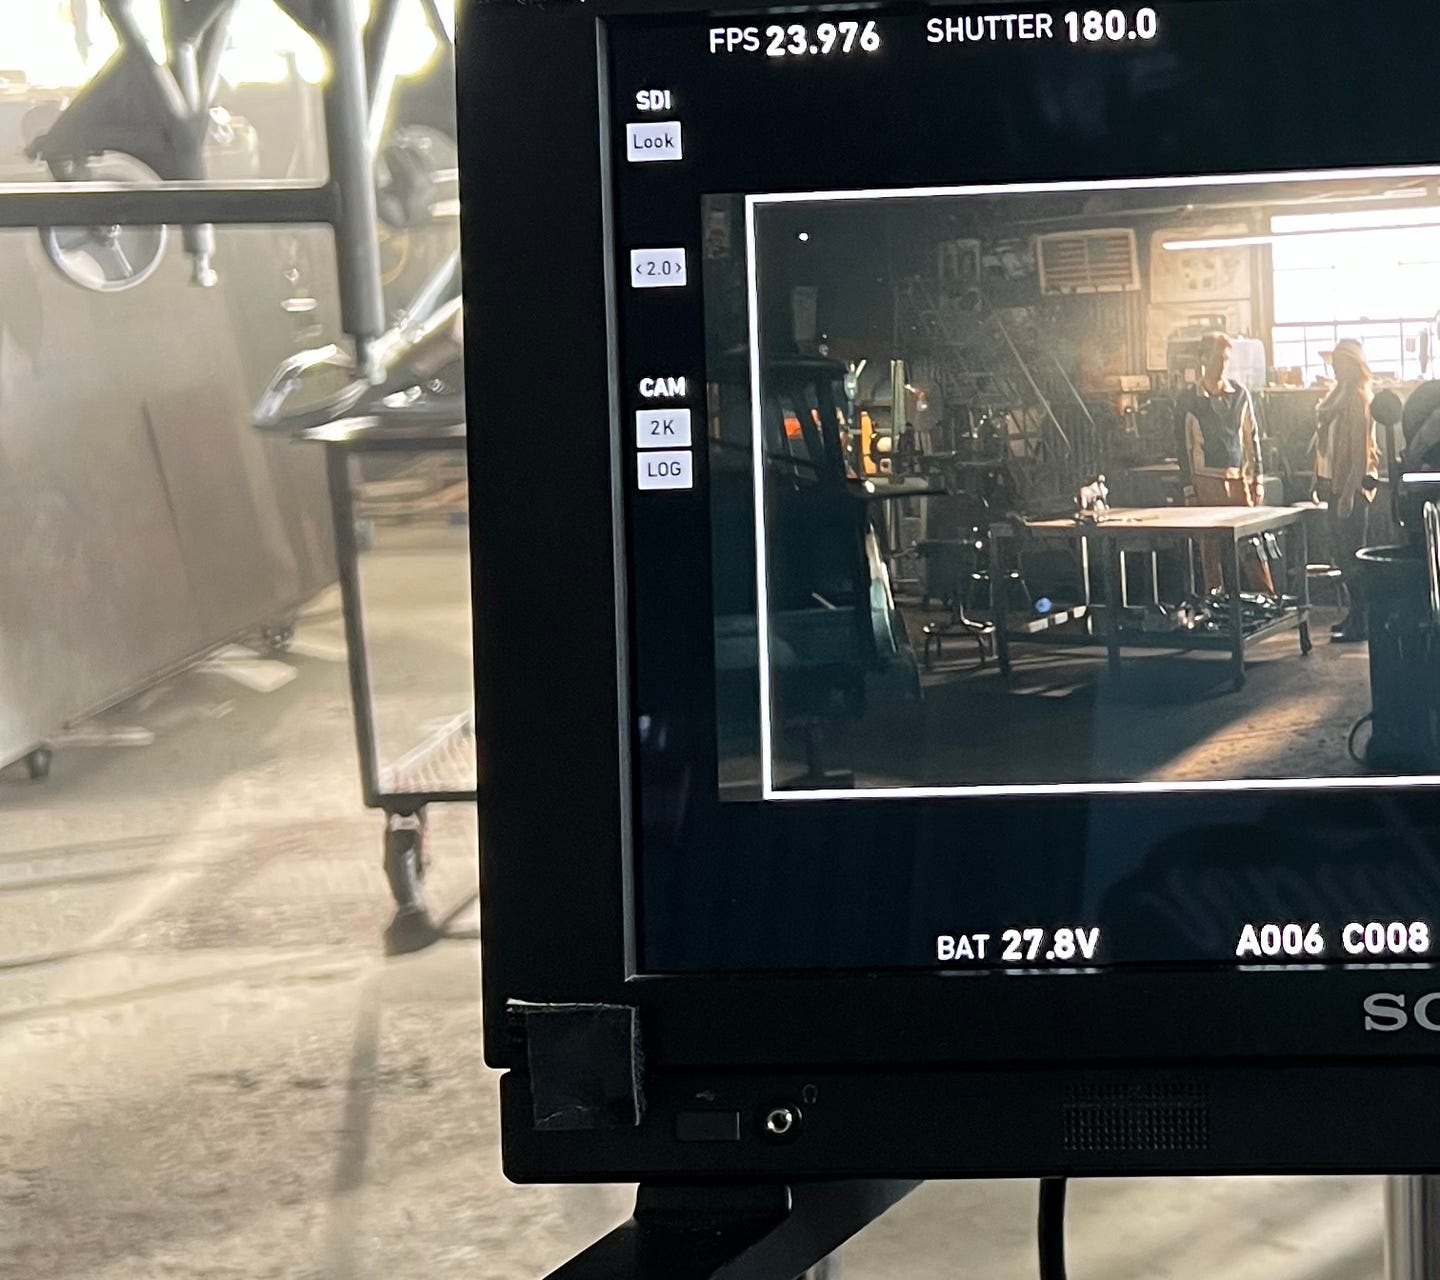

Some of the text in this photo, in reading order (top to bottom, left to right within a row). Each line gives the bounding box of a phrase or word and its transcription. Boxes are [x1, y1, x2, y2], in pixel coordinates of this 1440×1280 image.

[708, 7, 1158, 57] FPS 23.976 SHUTTER 180.0
[635, 89, 671, 111] SDI
[632, 132, 675, 150] Look
[638, 376, 686, 398] CAM
[650, 419, 675, 436] 2K
[647, 461, 682, 478] LOG
[937, 933, 991, 961] BAT
[1001, 926, 1100, 961] 27.8V
[1236, 923, 1325, 957] A006
[1342, 921, 1430, 954] C008
